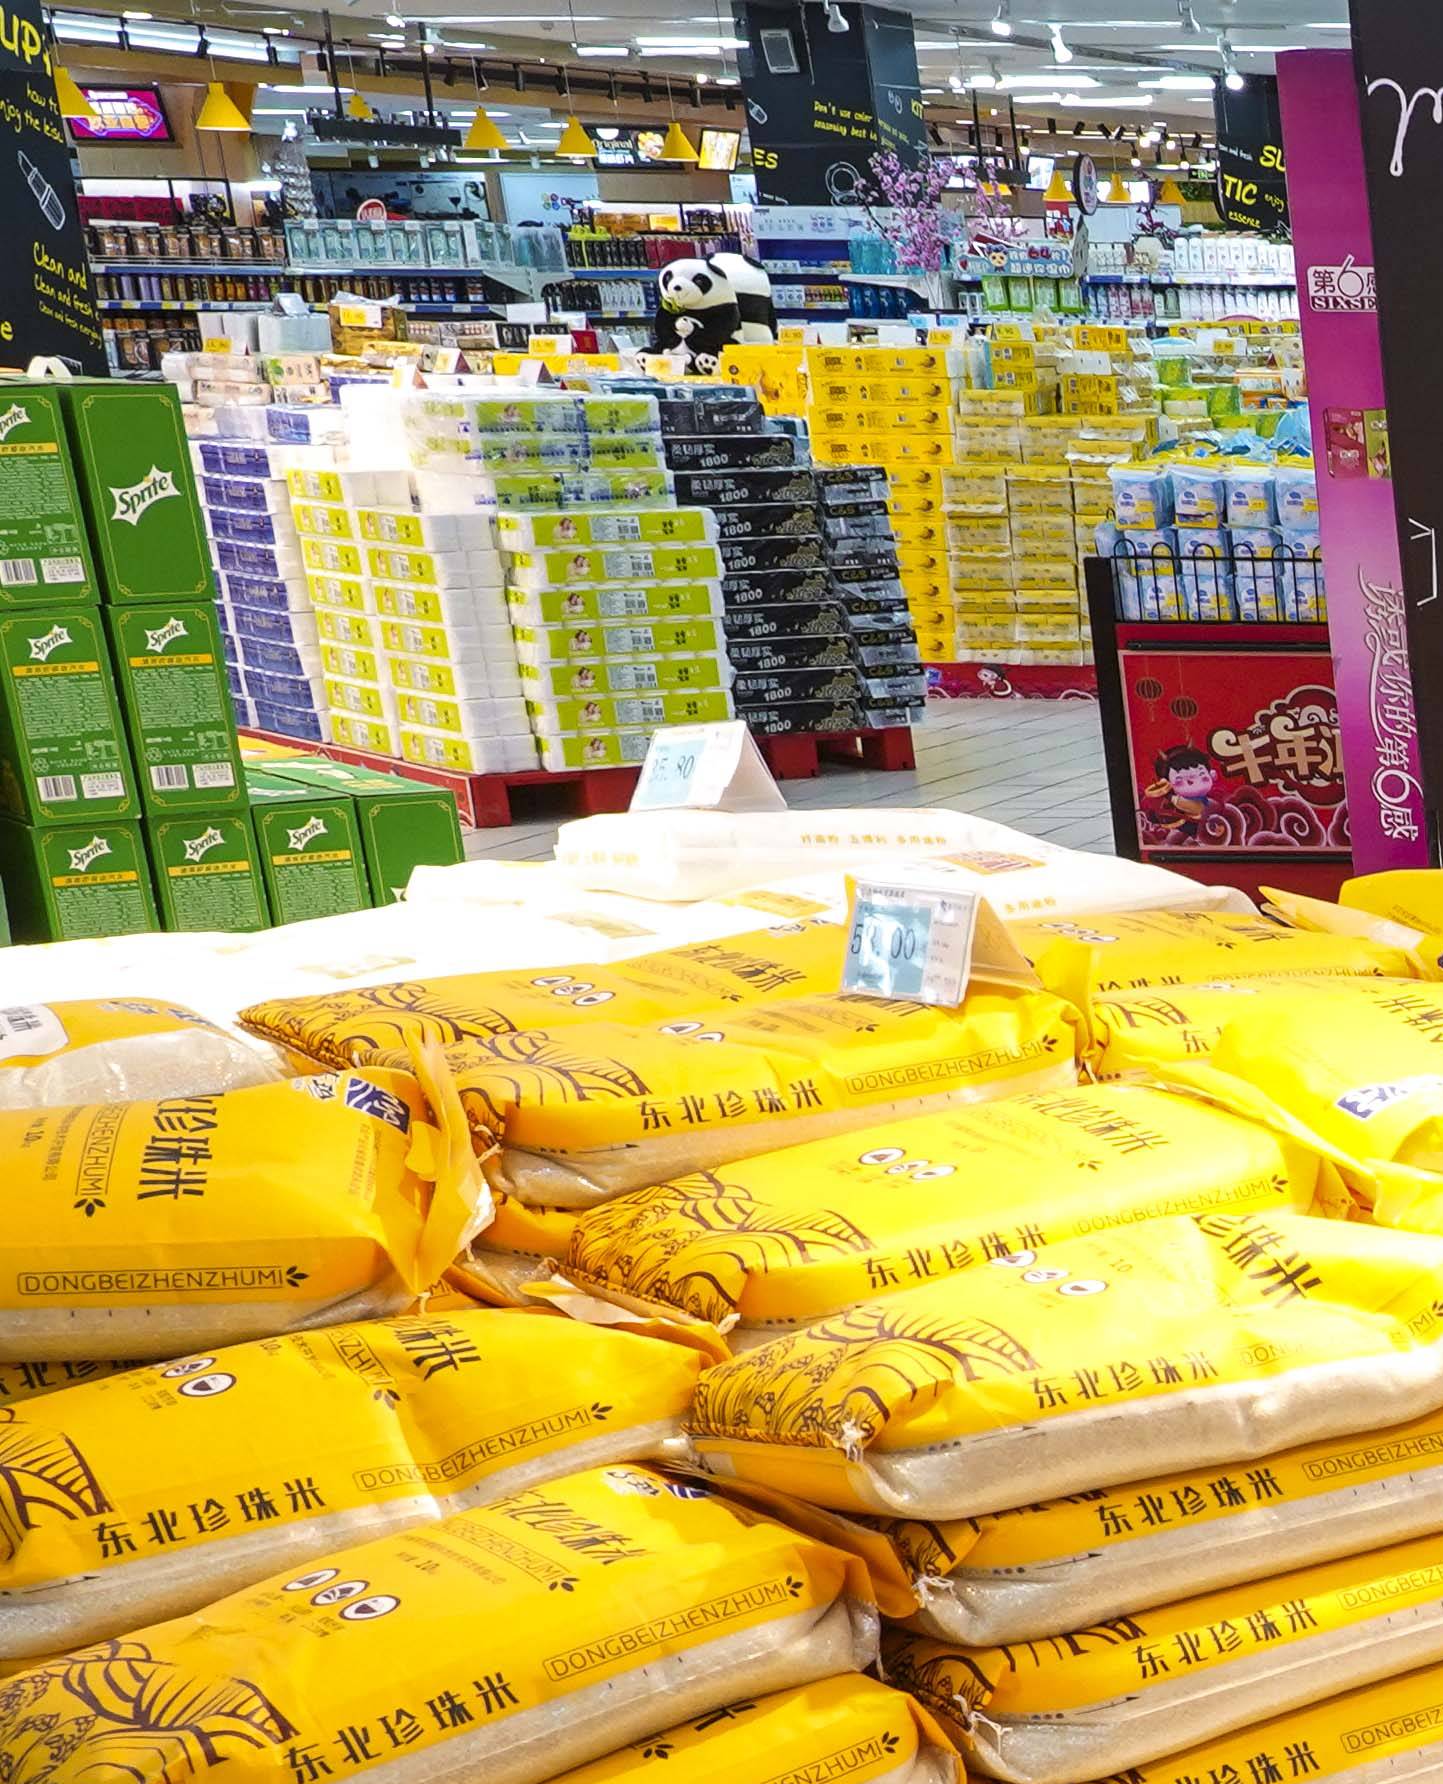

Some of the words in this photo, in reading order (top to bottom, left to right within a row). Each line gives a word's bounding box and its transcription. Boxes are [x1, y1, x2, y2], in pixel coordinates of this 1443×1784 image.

[1223, 174, 1258, 205] TIC
[119, 475, 174, 517] Sprite
[32, 630, 69, 655] Sprite
[149, 624, 185, 650] Sprite
[186, 833, 223, 858] Sprite
[290, 823, 325, 847] Sprite
[638, 1083, 823, 1130] 东北珍珠米
[25, 1269, 283, 1294] DONGBEIZHENZHUMI
[1033, 1351, 1217, 1409] 东北珍珠米
[359, 1410, 590, 1489] DONGBEIZHENZHUMI
[93, 1478, 327, 1557] 东北珍珠米
[1137, 1598, 1317, 1679] 东北珍珠米
